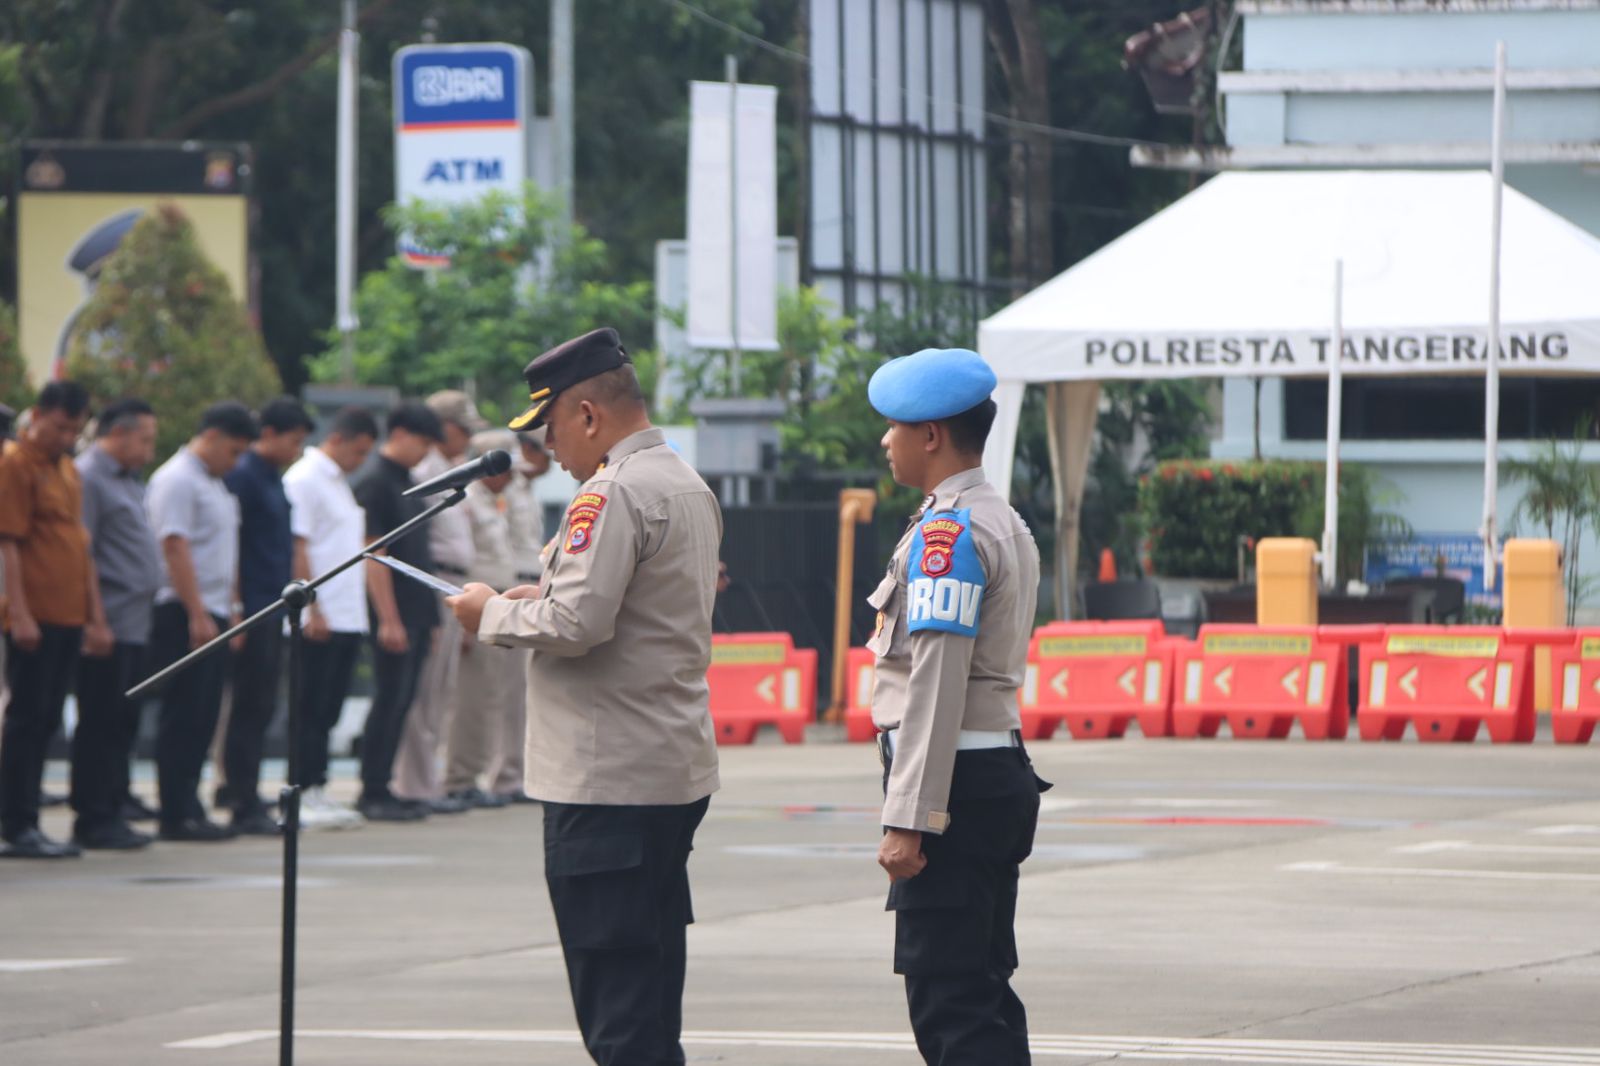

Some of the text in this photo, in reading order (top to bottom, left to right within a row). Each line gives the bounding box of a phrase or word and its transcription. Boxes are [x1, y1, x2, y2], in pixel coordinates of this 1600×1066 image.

[451, 66, 504, 102] BRI
[425, 159, 504, 183] ATM
[1085, 338, 1296, 366] POLRESTA
